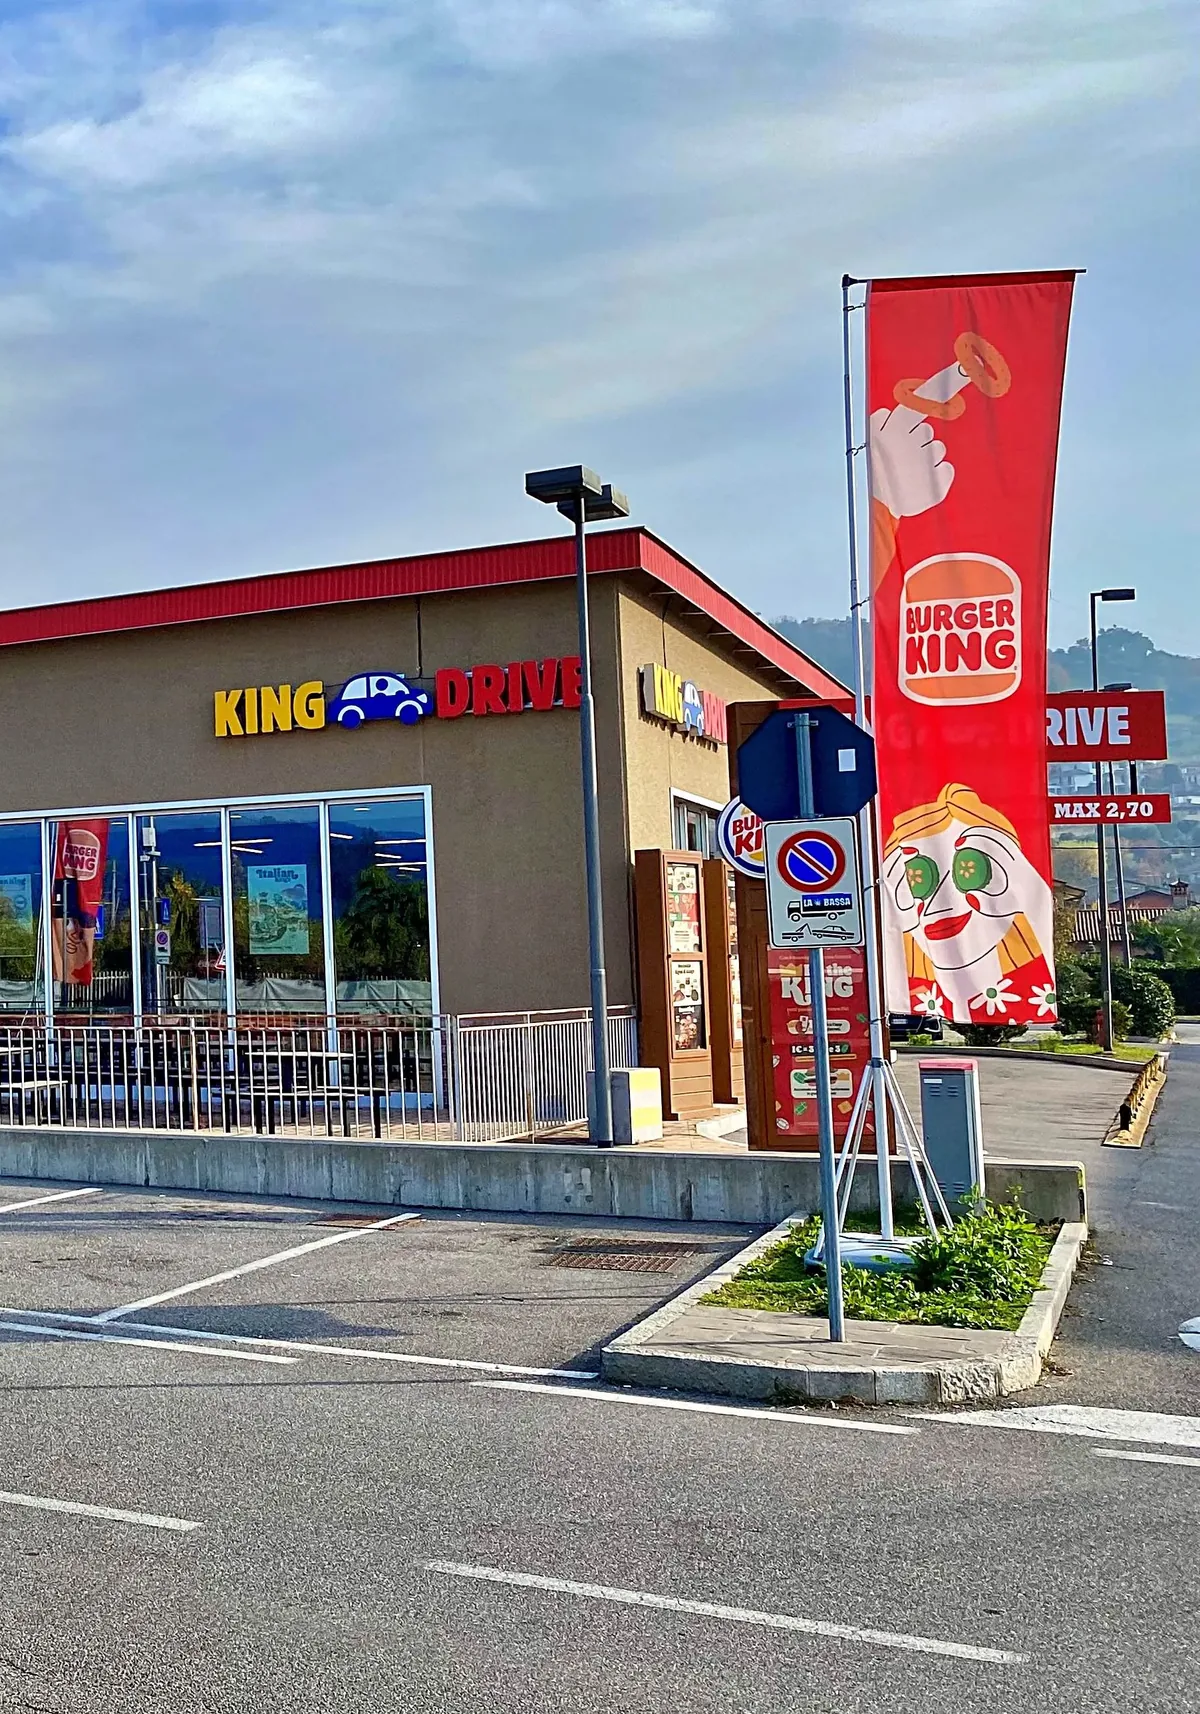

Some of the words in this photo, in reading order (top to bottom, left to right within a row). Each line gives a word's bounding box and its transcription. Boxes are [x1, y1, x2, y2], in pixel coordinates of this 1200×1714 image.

[906, 599, 1015, 634] BURGER
[906, 629, 1016, 675] KING
[215, 681, 326, 737] KING
[435, 656, 582, 718] DRIVE
[653, 662, 683, 723] KING
[1046, 706, 1132, 746] RIVE
[1054, 802, 1101, 819] MAX
[1105, 801, 1154, 821] 2,70
[735, 828, 763, 856] KI
[803, 898, 814, 908] LA
[823, 897, 851, 907] BASSA
[826, 962, 853, 976] the
